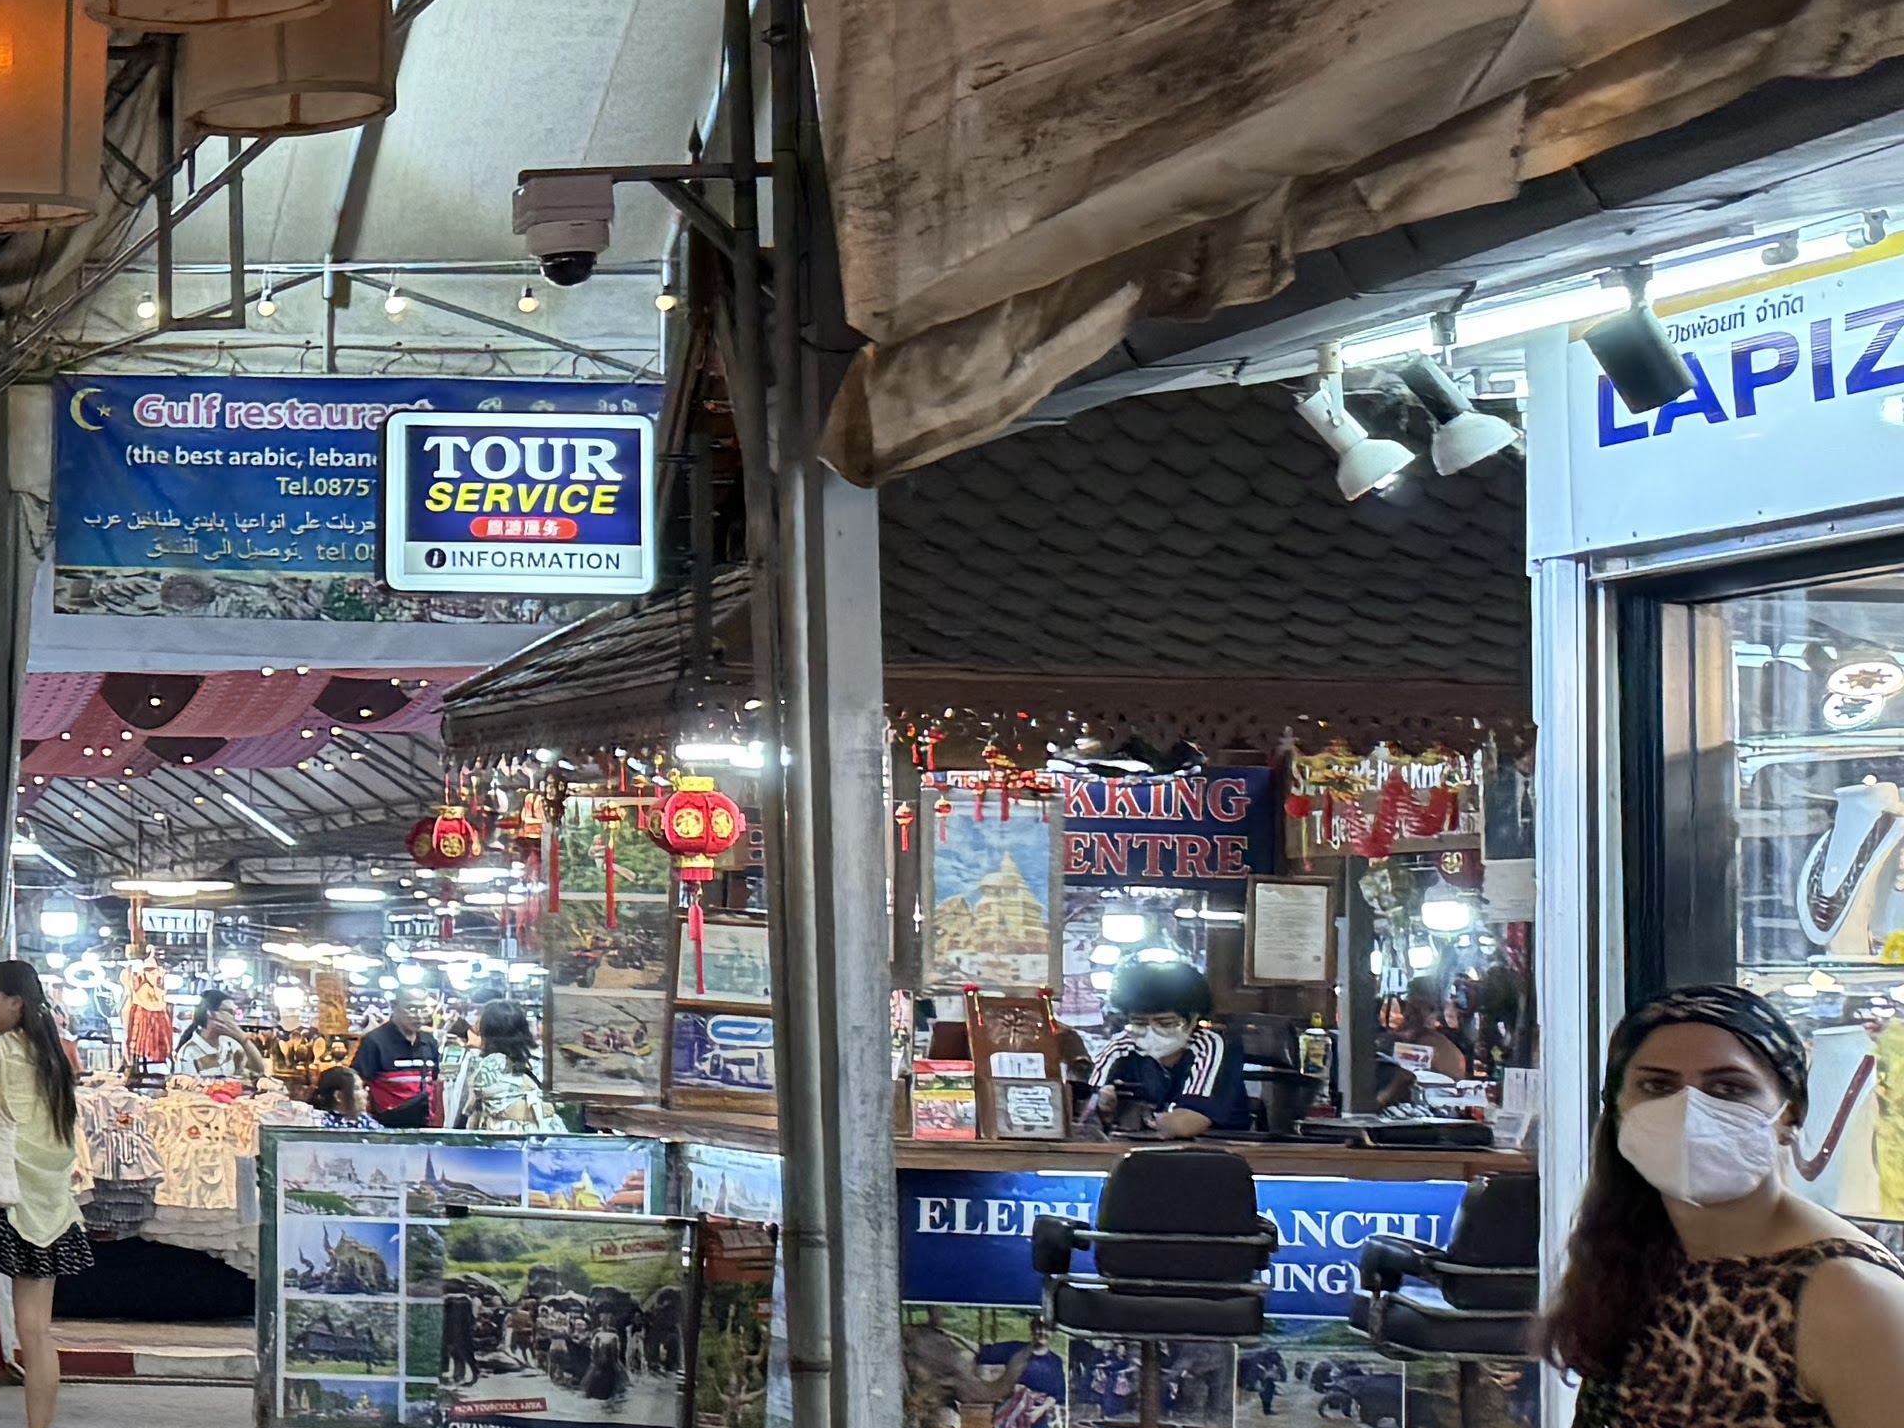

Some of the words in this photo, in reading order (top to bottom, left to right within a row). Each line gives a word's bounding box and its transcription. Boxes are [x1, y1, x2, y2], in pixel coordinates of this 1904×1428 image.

[133, 392, 222, 429] Gulf
[225, 397, 434, 431] restaura
[126, 444, 168, 467] (the
[175, 445, 223, 465] best
[229, 446, 303, 469] arabic,
[308, 447, 377, 467] leban
[423, 436, 623, 481] TOUR
[276, 476, 377, 497] Tel.0875
[425, 482, 620, 514] SERVICE
[451, 550, 620, 570] INFORMATION
[1063, 831, 1250, 879] ENTRE
